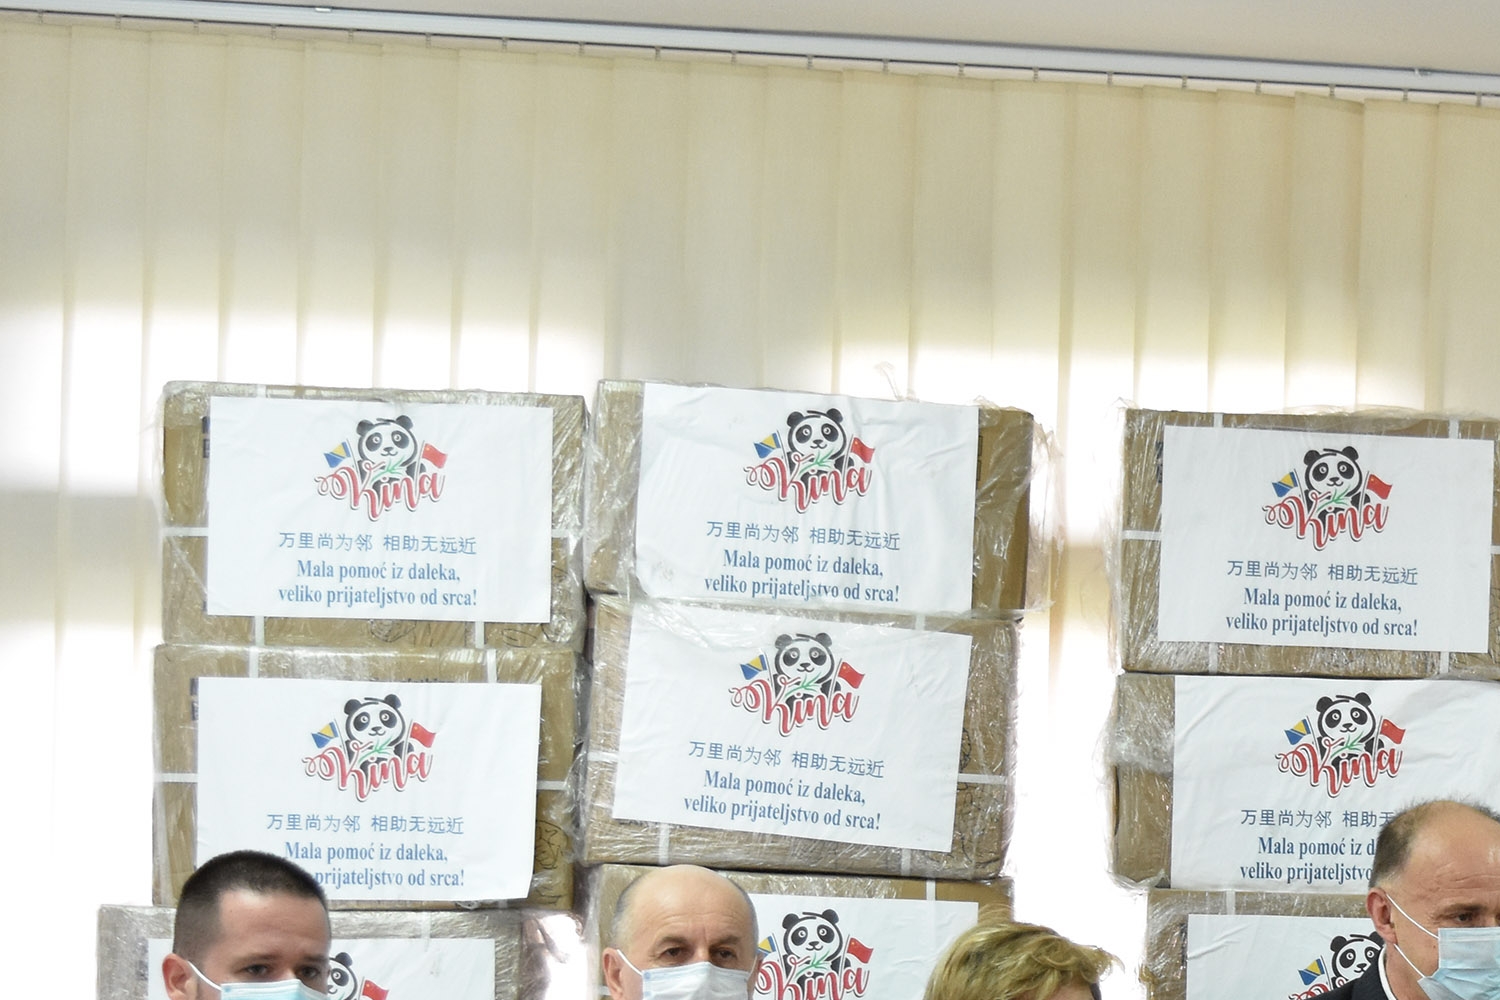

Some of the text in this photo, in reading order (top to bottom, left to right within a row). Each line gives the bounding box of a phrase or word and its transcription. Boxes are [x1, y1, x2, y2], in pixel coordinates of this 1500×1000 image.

[296, 559, 460, 584] Mala pomoć iz daleka,
[722, 549, 883, 580] Mala pomoć iz daleka,
[278, 584, 477, 609] veliko prijateljstvo od srca!
[703, 574, 899, 602] veliko prijateljstvo od srca!
[1243, 587, 1402, 615] Mala pomoć iz daleka,
[1225, 612, 1418, 638] veliko prijateljstvo od srca!
[703, 769, 865, 807] Mala pomoć iz daleka,
[683, 794, 881, 830] veliko prijateljstvo od srca!
[284, 841, 448, 865] Mala pomoć iz daleka,
[1257, 836, 1294, 855] Mala
[1298, 836, 1346, 860] pomoć
[1350, 837, 1363, 855] iz
[313, 867, 465, 890] prijateljstvo od srca!
[1239, 861, 1282, 880] veliko
